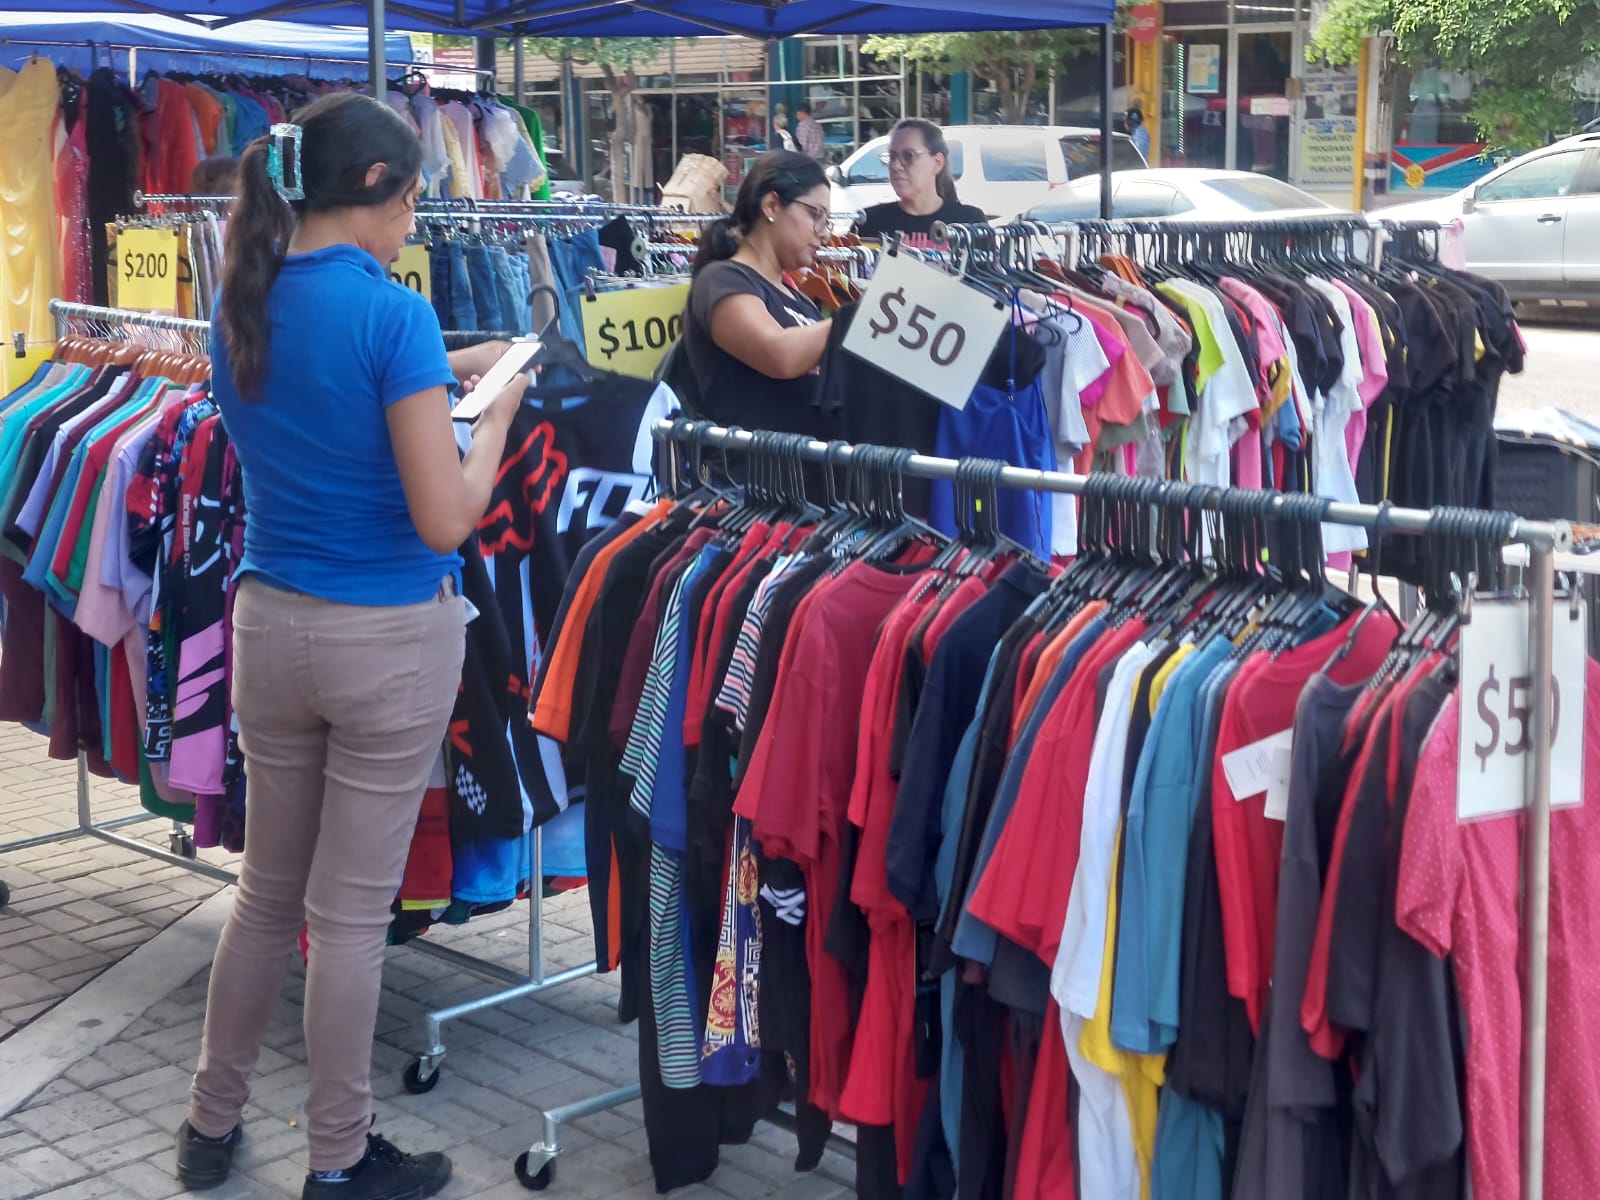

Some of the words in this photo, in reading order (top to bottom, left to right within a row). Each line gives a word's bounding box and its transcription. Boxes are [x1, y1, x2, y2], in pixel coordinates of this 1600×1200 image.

[124, 248, 168, 282] $200
[868, 286, 966, 367] $50
[556, 466, 657, 534] FO
